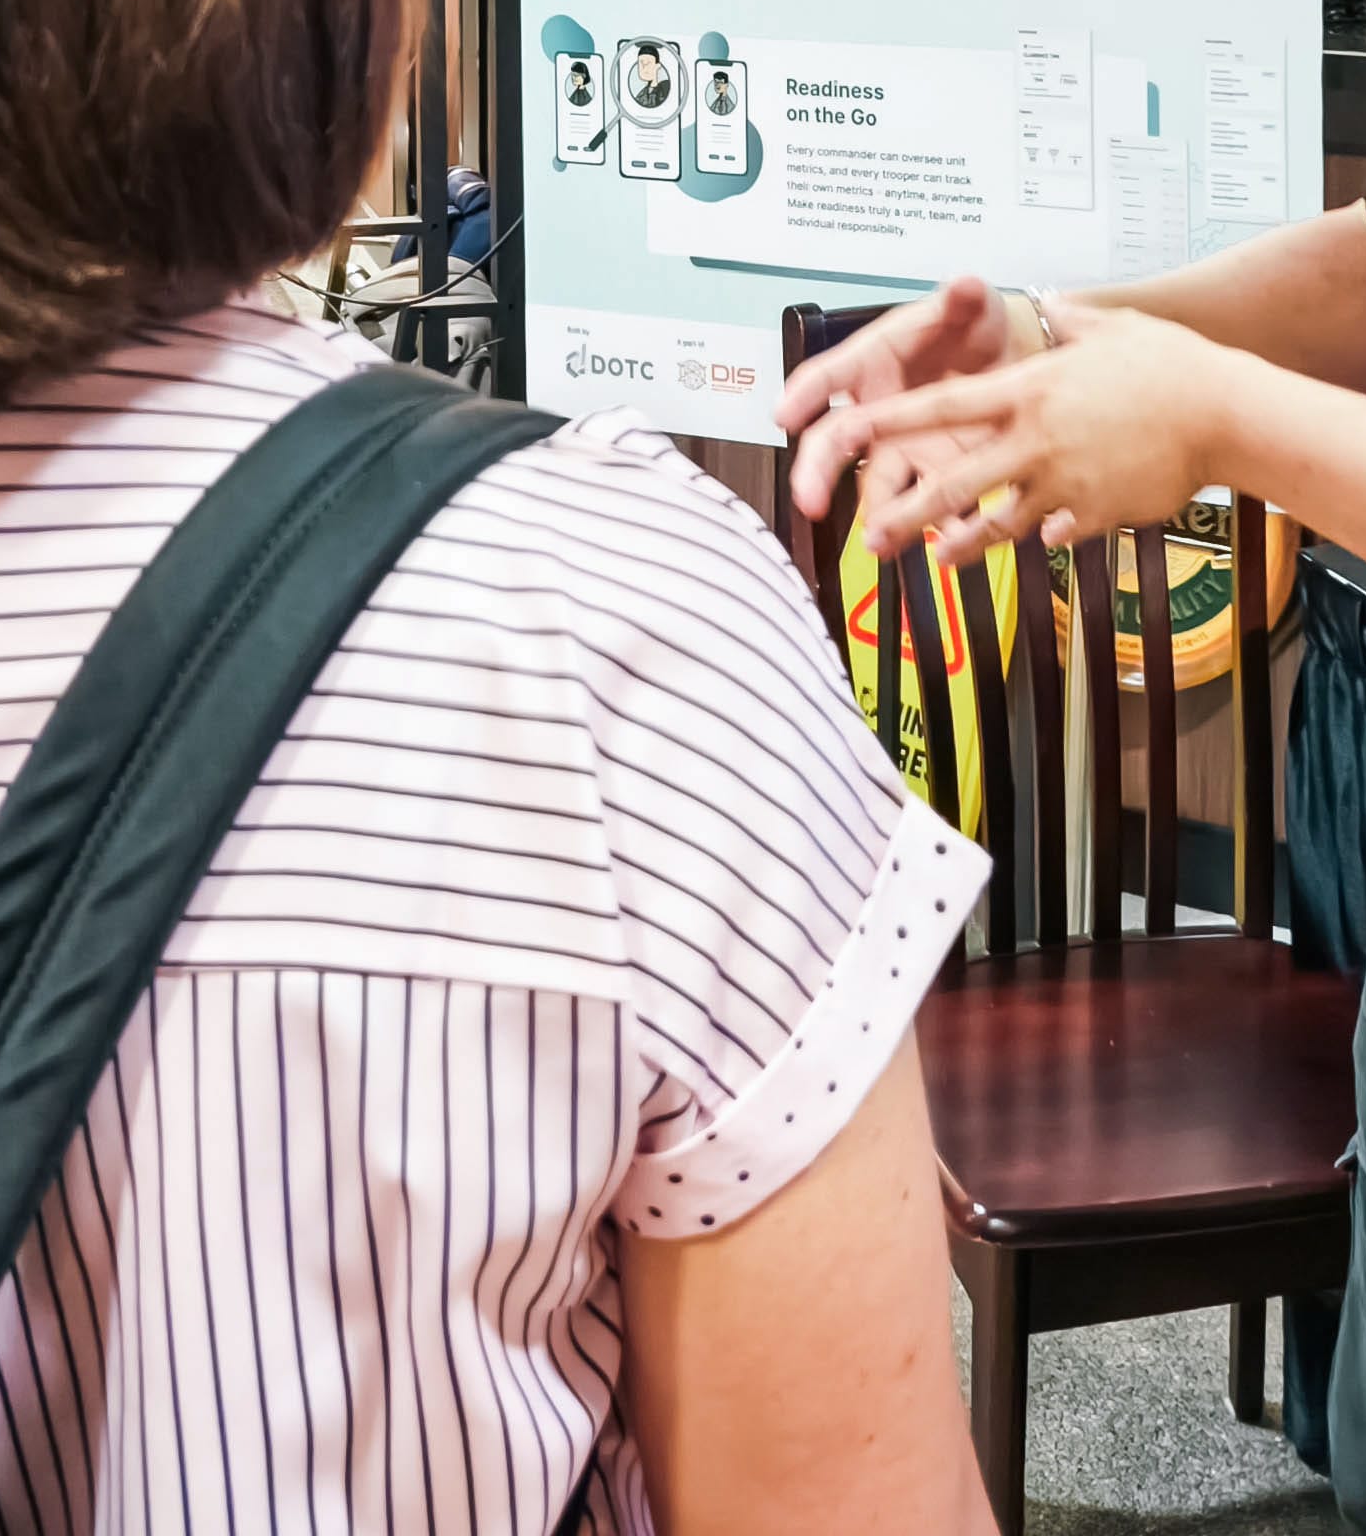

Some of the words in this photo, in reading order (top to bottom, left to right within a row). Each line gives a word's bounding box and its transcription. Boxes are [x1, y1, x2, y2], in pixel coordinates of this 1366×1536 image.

[786, 79, 884, 100] Readiness
[787, 108, 809, 122] on
[815, 107, 845, 124] the
[851, 109, 877, 126] Go
[787, 145, 815, 157] Every
[817, 149, 876, 160] commander
[880, 153, 898, 161] can
[902, 155, 942, 165] oversee
[947, 156, 966, 166] unit
[787, 163, 826, 175] metrics,
[829, 167, 848, 177] and
[851, 170, 879, 180] every
[883, 170, 919, 182] trooper
[924, 173, 942, 183] can
[945, 175, 971, 185] track
[787, 181, 809, 192] their
[812, 184, 833, 193] own
[836, 186, 873, 196] metrics
[885, 189, 929, 201] anytime,
[932, 192, 985, 205] anywhere.
[788, 199, 813, 210] Make
[817, 202, 865, 214] readiness
[869, 206, 891, 218] truly
[904, 208, 926, 220] unit,
[929, 211, 958, 222] team,
[962, 214, 981, 223] and
[788, 217, 834, 229] individual
[838, 222, 907, 237] responsibility.
[591, 354, 654, 380] DOTC
[711, 364, 755, 385] DIS
